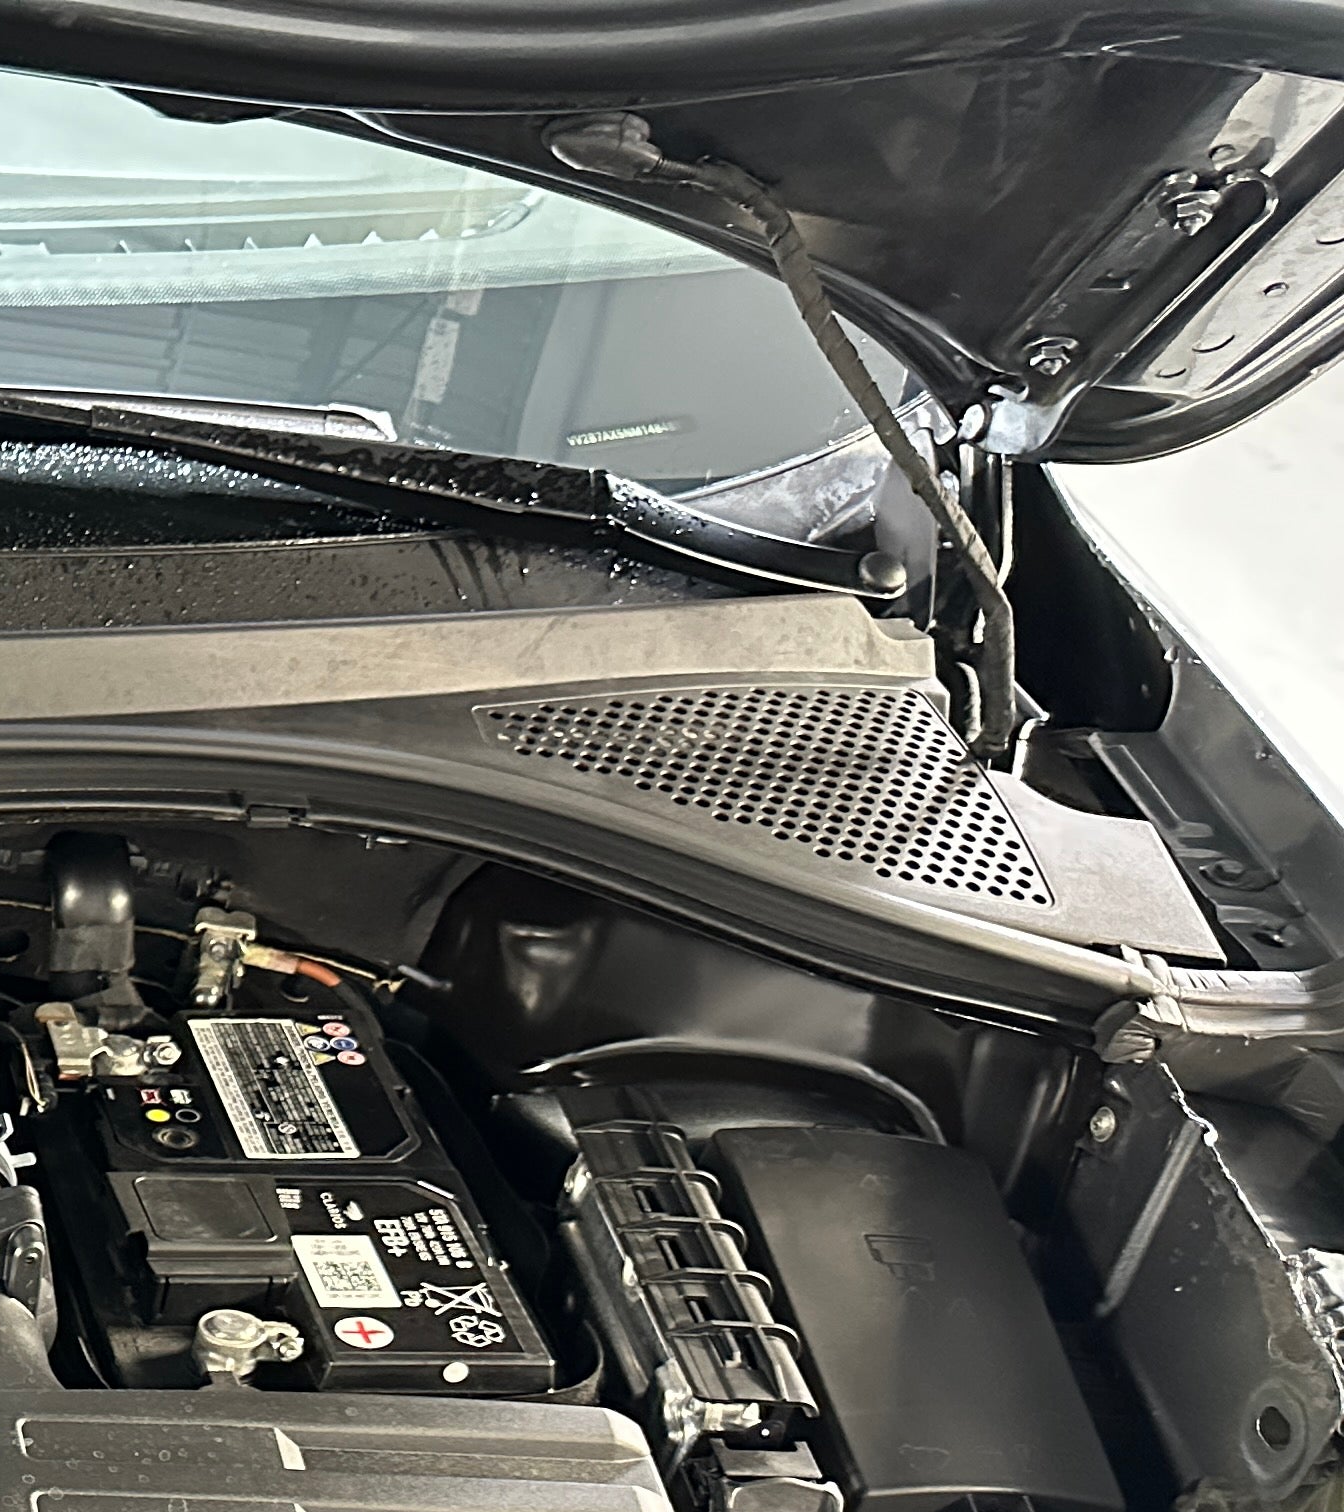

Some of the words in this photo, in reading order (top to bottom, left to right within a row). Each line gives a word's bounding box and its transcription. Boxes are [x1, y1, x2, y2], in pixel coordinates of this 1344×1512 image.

[320, 1191, 348, 1229] CLARIOS
[373, 1219, 410, 1257] EFB+
[400, 1290, 424, 1307] Pb
